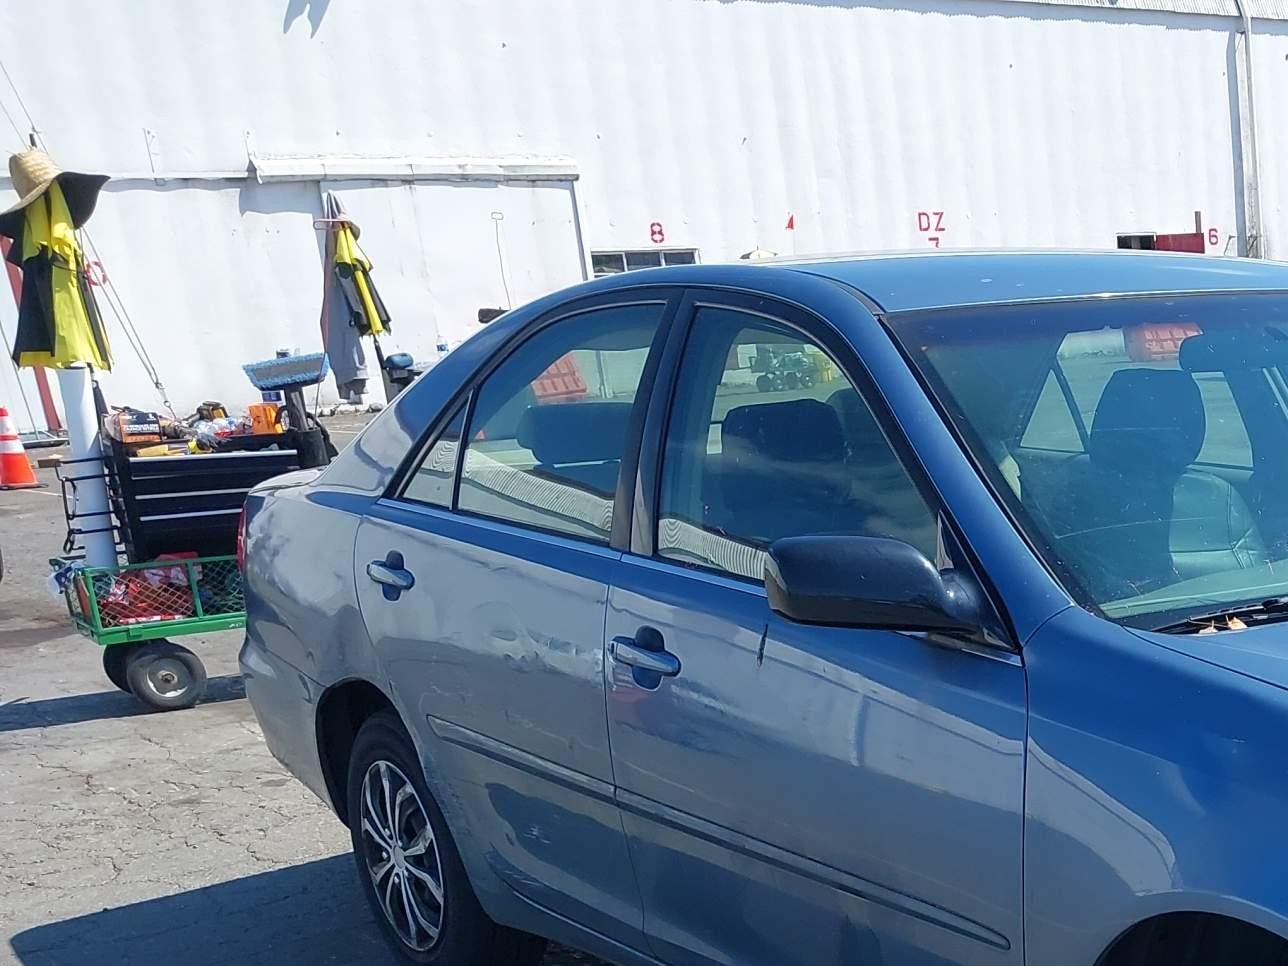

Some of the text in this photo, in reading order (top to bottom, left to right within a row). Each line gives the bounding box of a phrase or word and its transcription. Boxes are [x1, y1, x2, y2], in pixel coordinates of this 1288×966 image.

[918, 212, 945, 231] DZ
[650, 222, 664, 243] 8
[1209, 228, 1219, 246] 6
